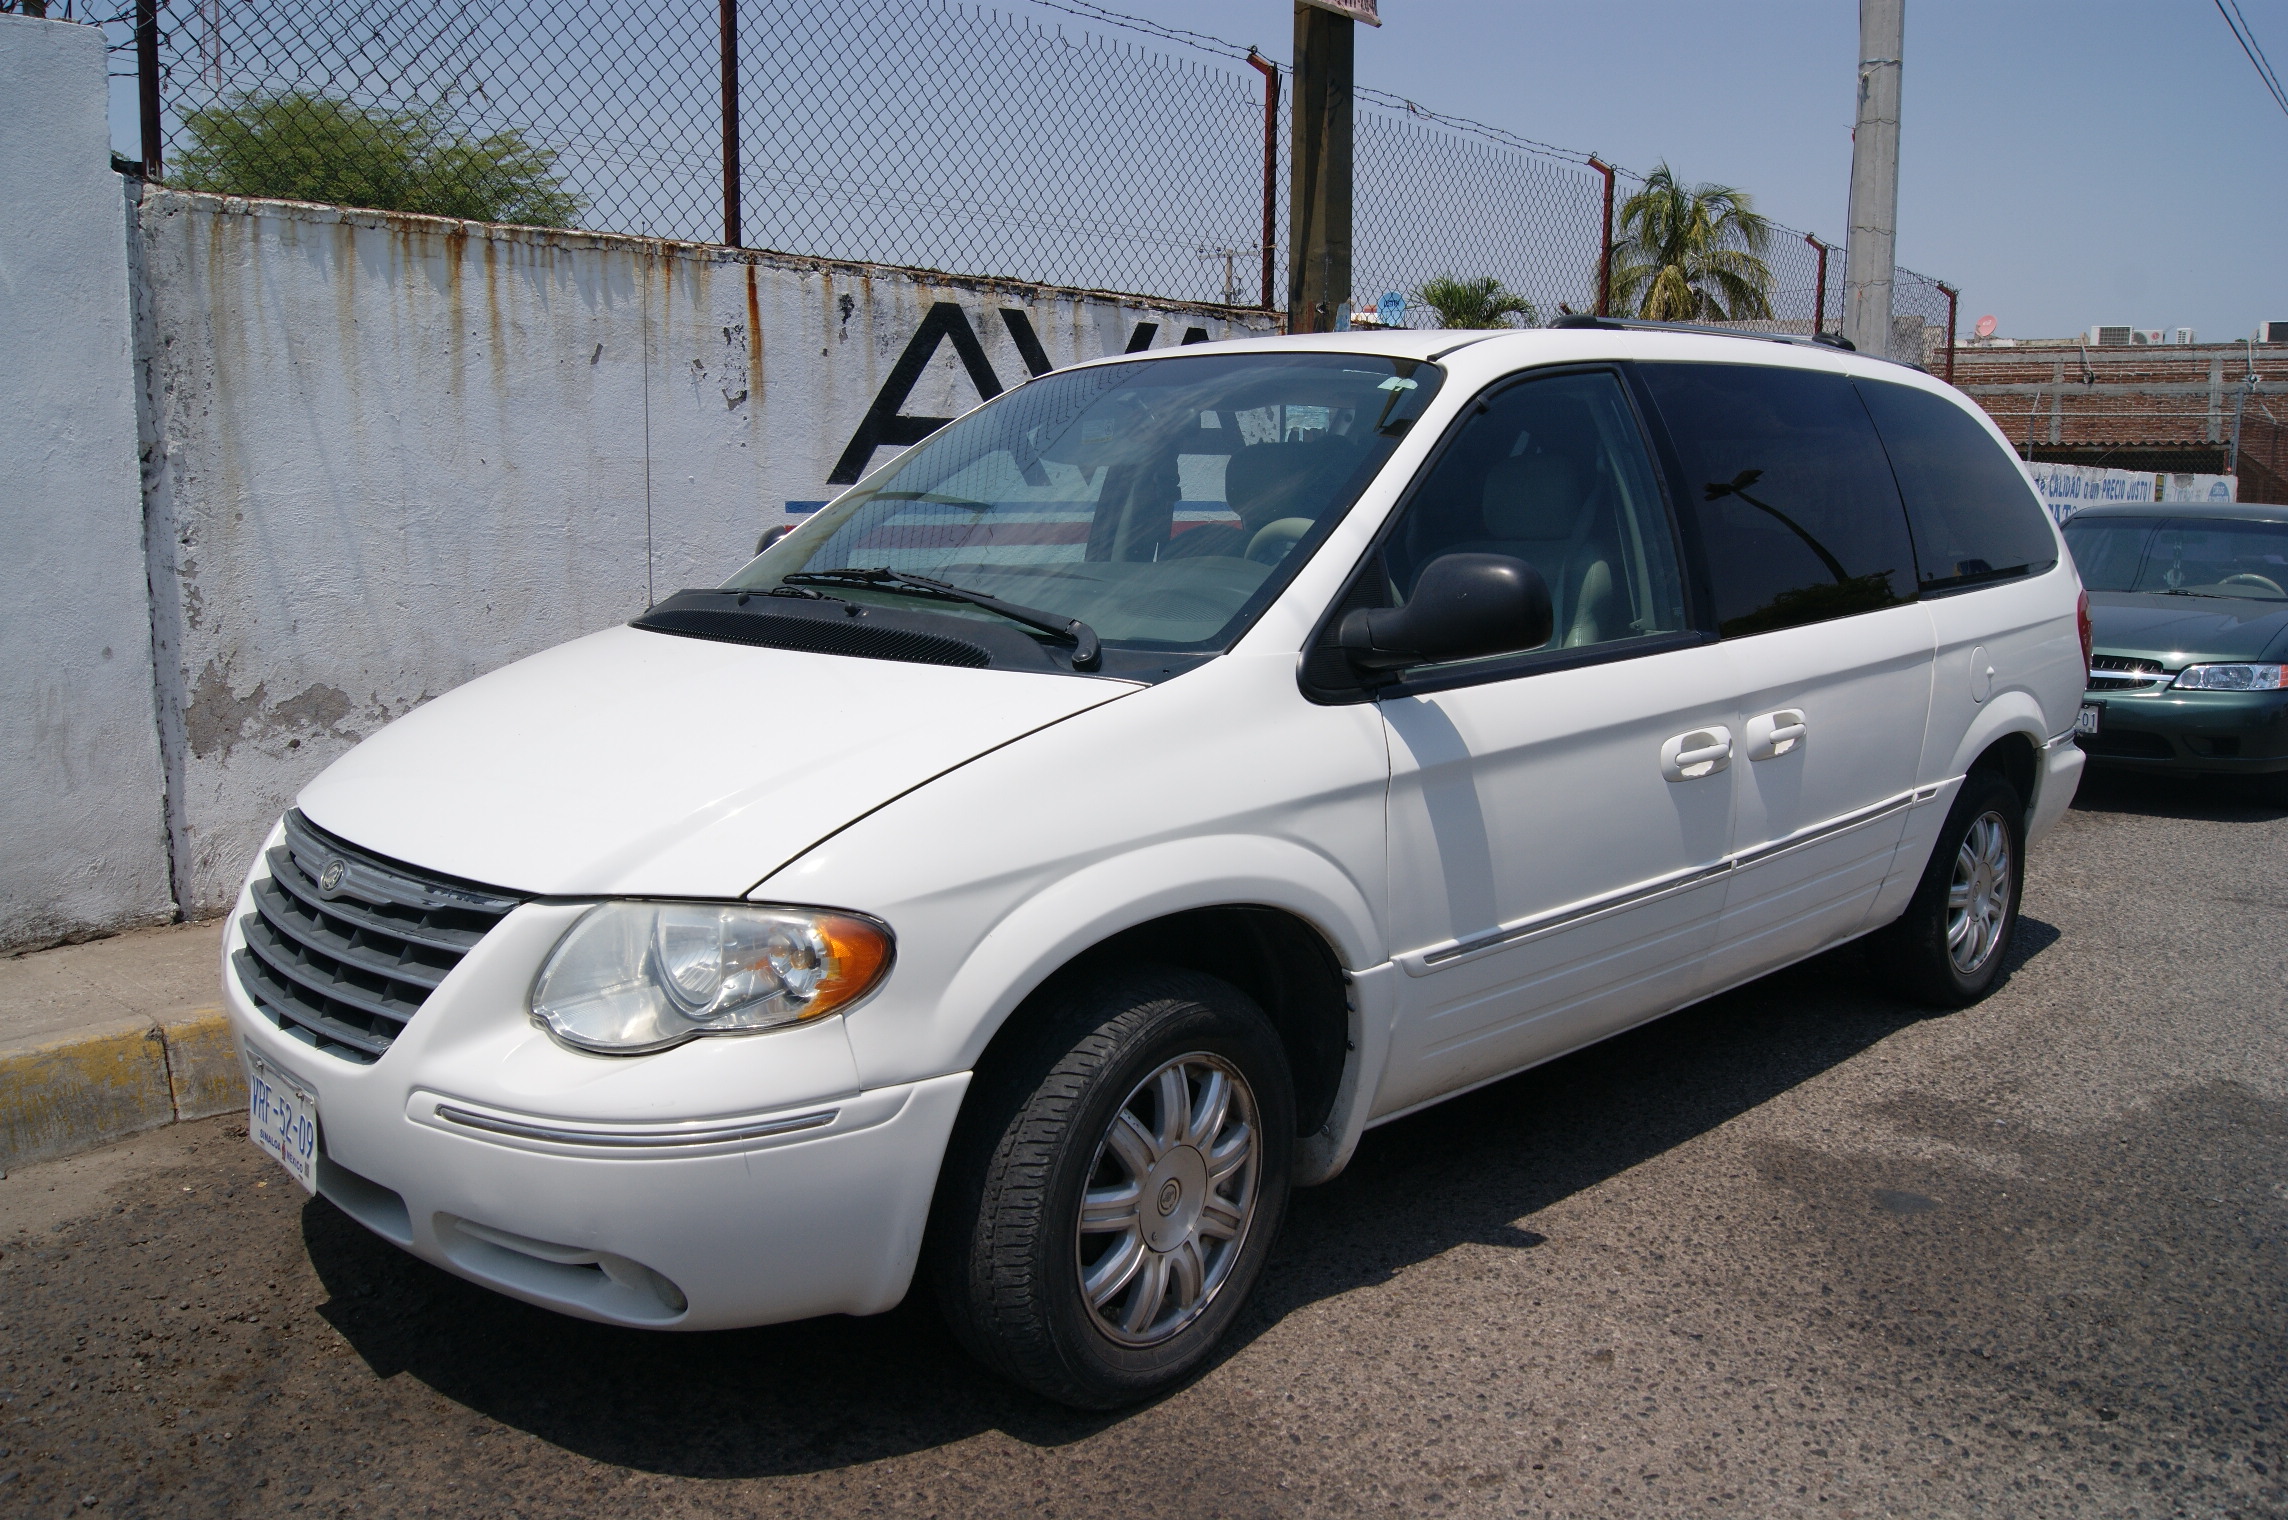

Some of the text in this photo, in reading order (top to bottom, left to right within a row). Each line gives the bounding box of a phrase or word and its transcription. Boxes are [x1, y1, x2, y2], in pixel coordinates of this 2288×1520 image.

[2049, 474, 2081, 498] CALIDAD
[2101, 479, 2126, 501] PRECIO
[259, 1129, 281, 1151] SINALOA
